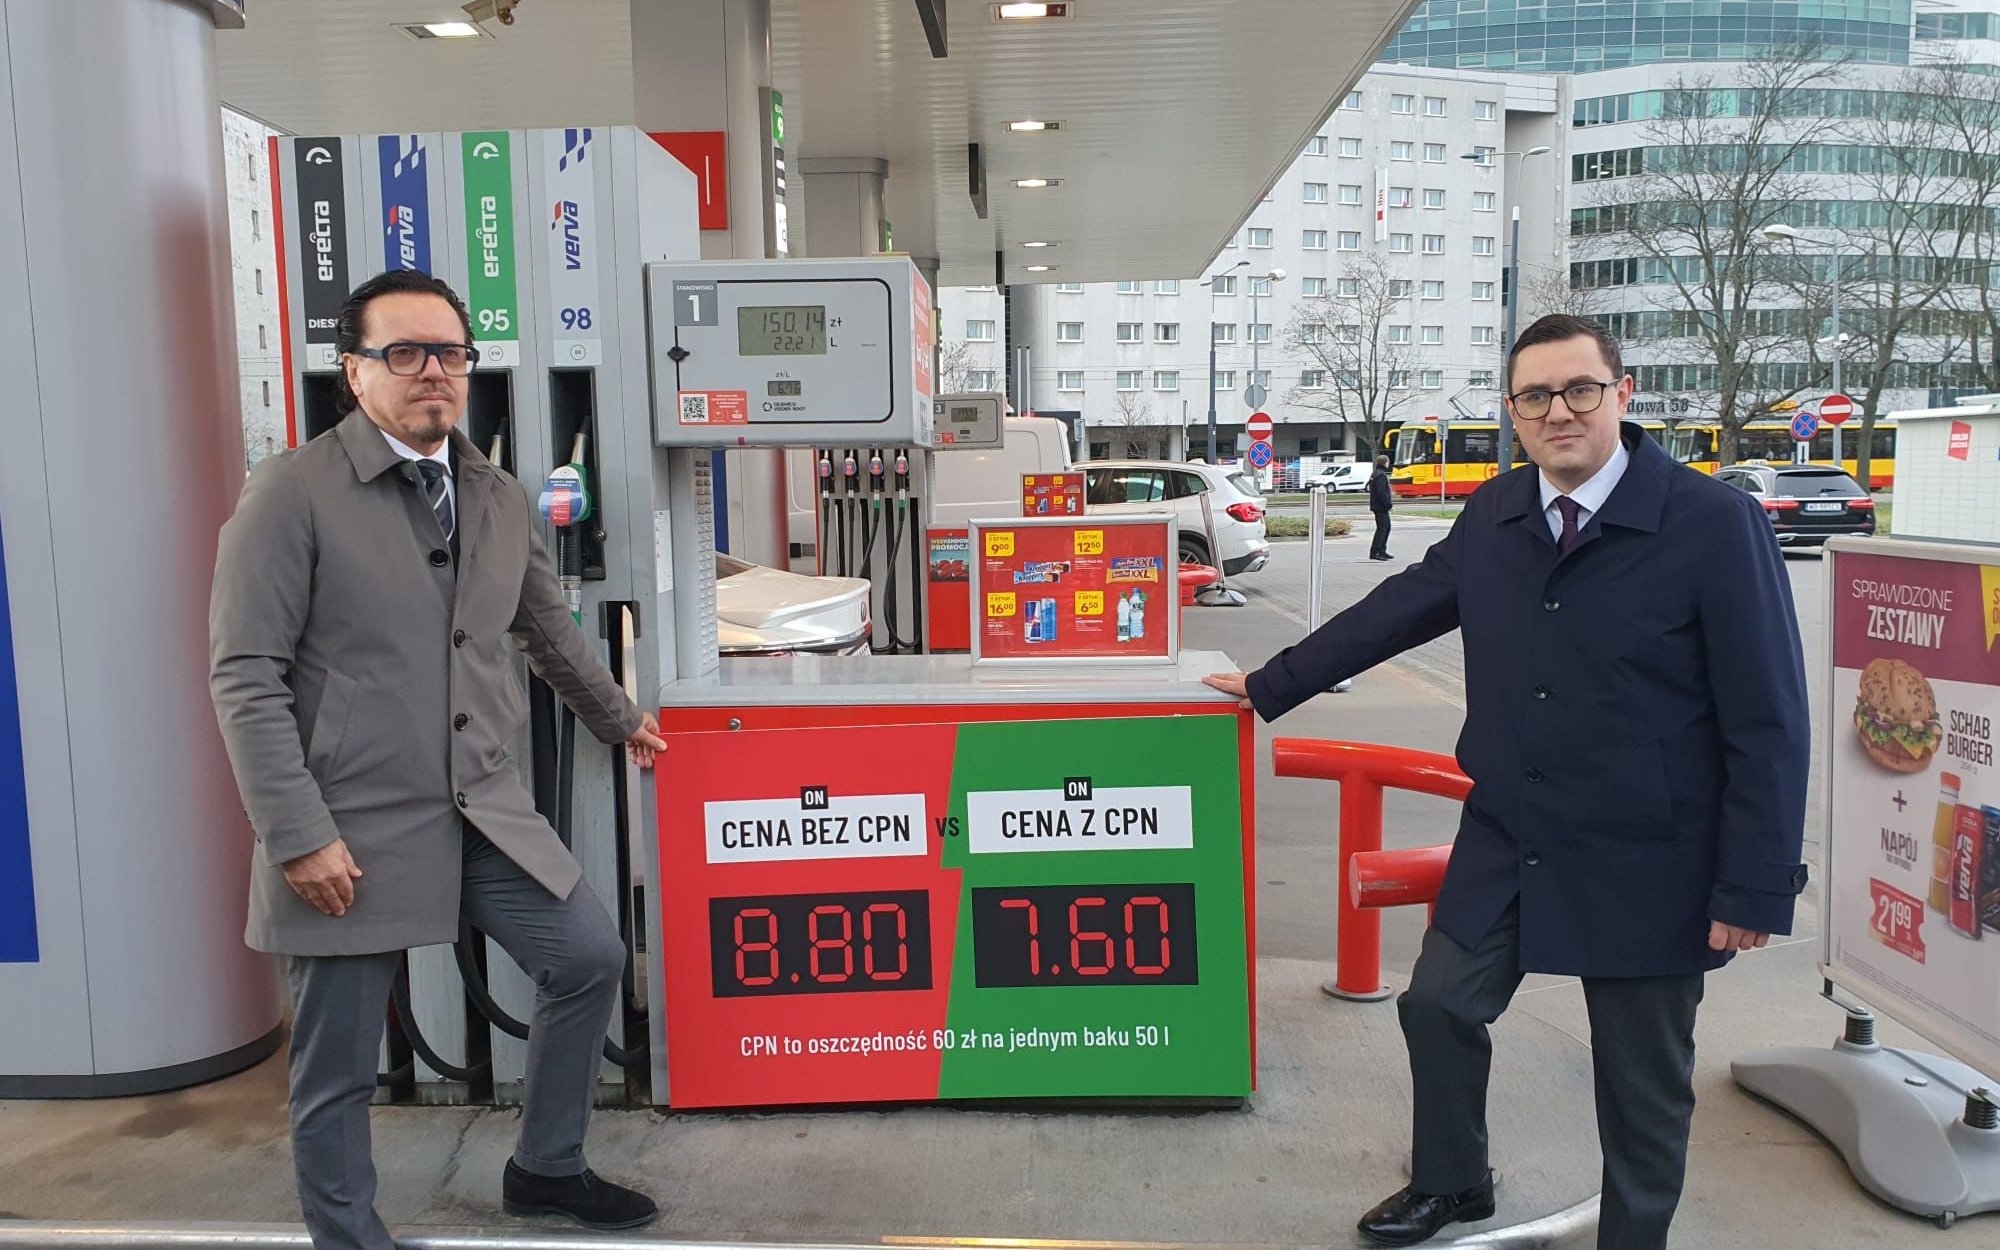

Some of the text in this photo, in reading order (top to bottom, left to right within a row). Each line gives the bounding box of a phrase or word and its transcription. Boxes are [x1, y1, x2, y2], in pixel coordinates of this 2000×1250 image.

[478, 309, 510, 332] 95
[560, 307, 592, 330] 98
[688, 295, 700, 322] 1
[936, 405, 942, 413] 3
[1627, 398, 1689, 412] dowa 58
[1131, 568, 1151, 579] XXL
[1852, 579, 1953, 611] SPRAWDZONE
[1867, 605, 1945, 649] ZESTAWY
[1950, 710, 1990, 740] SCHAB
[1947, 733, 1993, 767] BURGER
[806, 790, 824, 805] ON
[1069, 781, 1088, 797] ON
[722, 814, 911, 849] CENA BEZ CPN
[935, 816, 960, 838] VS
[1001, 807, 1159, 839] CENA Z CPN
[1881, 827, 1917, 862] NAPÓJ
[734, 904, 908, 986] 8.80
[1000, 896, 1169, 976] 7.60
[740, 1036, 778, 1057] CPN
[783, 1036, 802, 1055] to
[807, 1029, 928, 1058] oszczędność
[933, 1030, 955, 1050] 60
[961, 1029, 977, 1050] zł
[981, 1033, 1004, 1049] na
[1008, 1027, 1078, 1053] jednym
[1083, 1026, 1130, 1047] baku
[1135, 1025, 1158, 1046] 50
